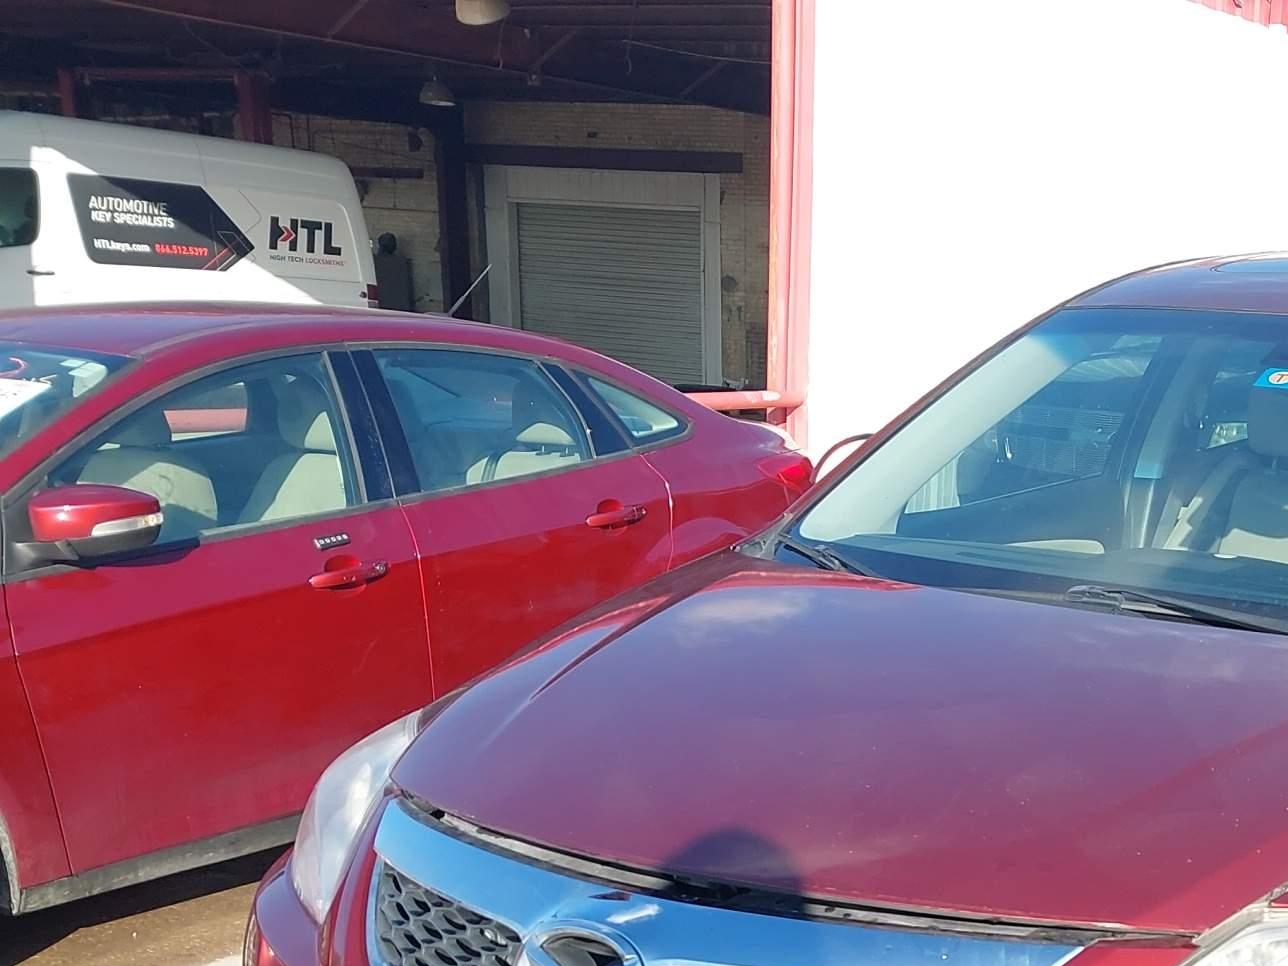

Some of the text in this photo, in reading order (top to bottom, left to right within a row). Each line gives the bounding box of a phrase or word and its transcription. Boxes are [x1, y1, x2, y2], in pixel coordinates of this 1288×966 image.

[89, 195, 169, 215] AUTOMOTIVE
[91, 210, 175, 228] KEY SPECIALISTS
[269, 215, 342, 257] HTL
[269, 254, 286, 262] HIGH
[305, 257, 345, 266] LOCKSMITHS
